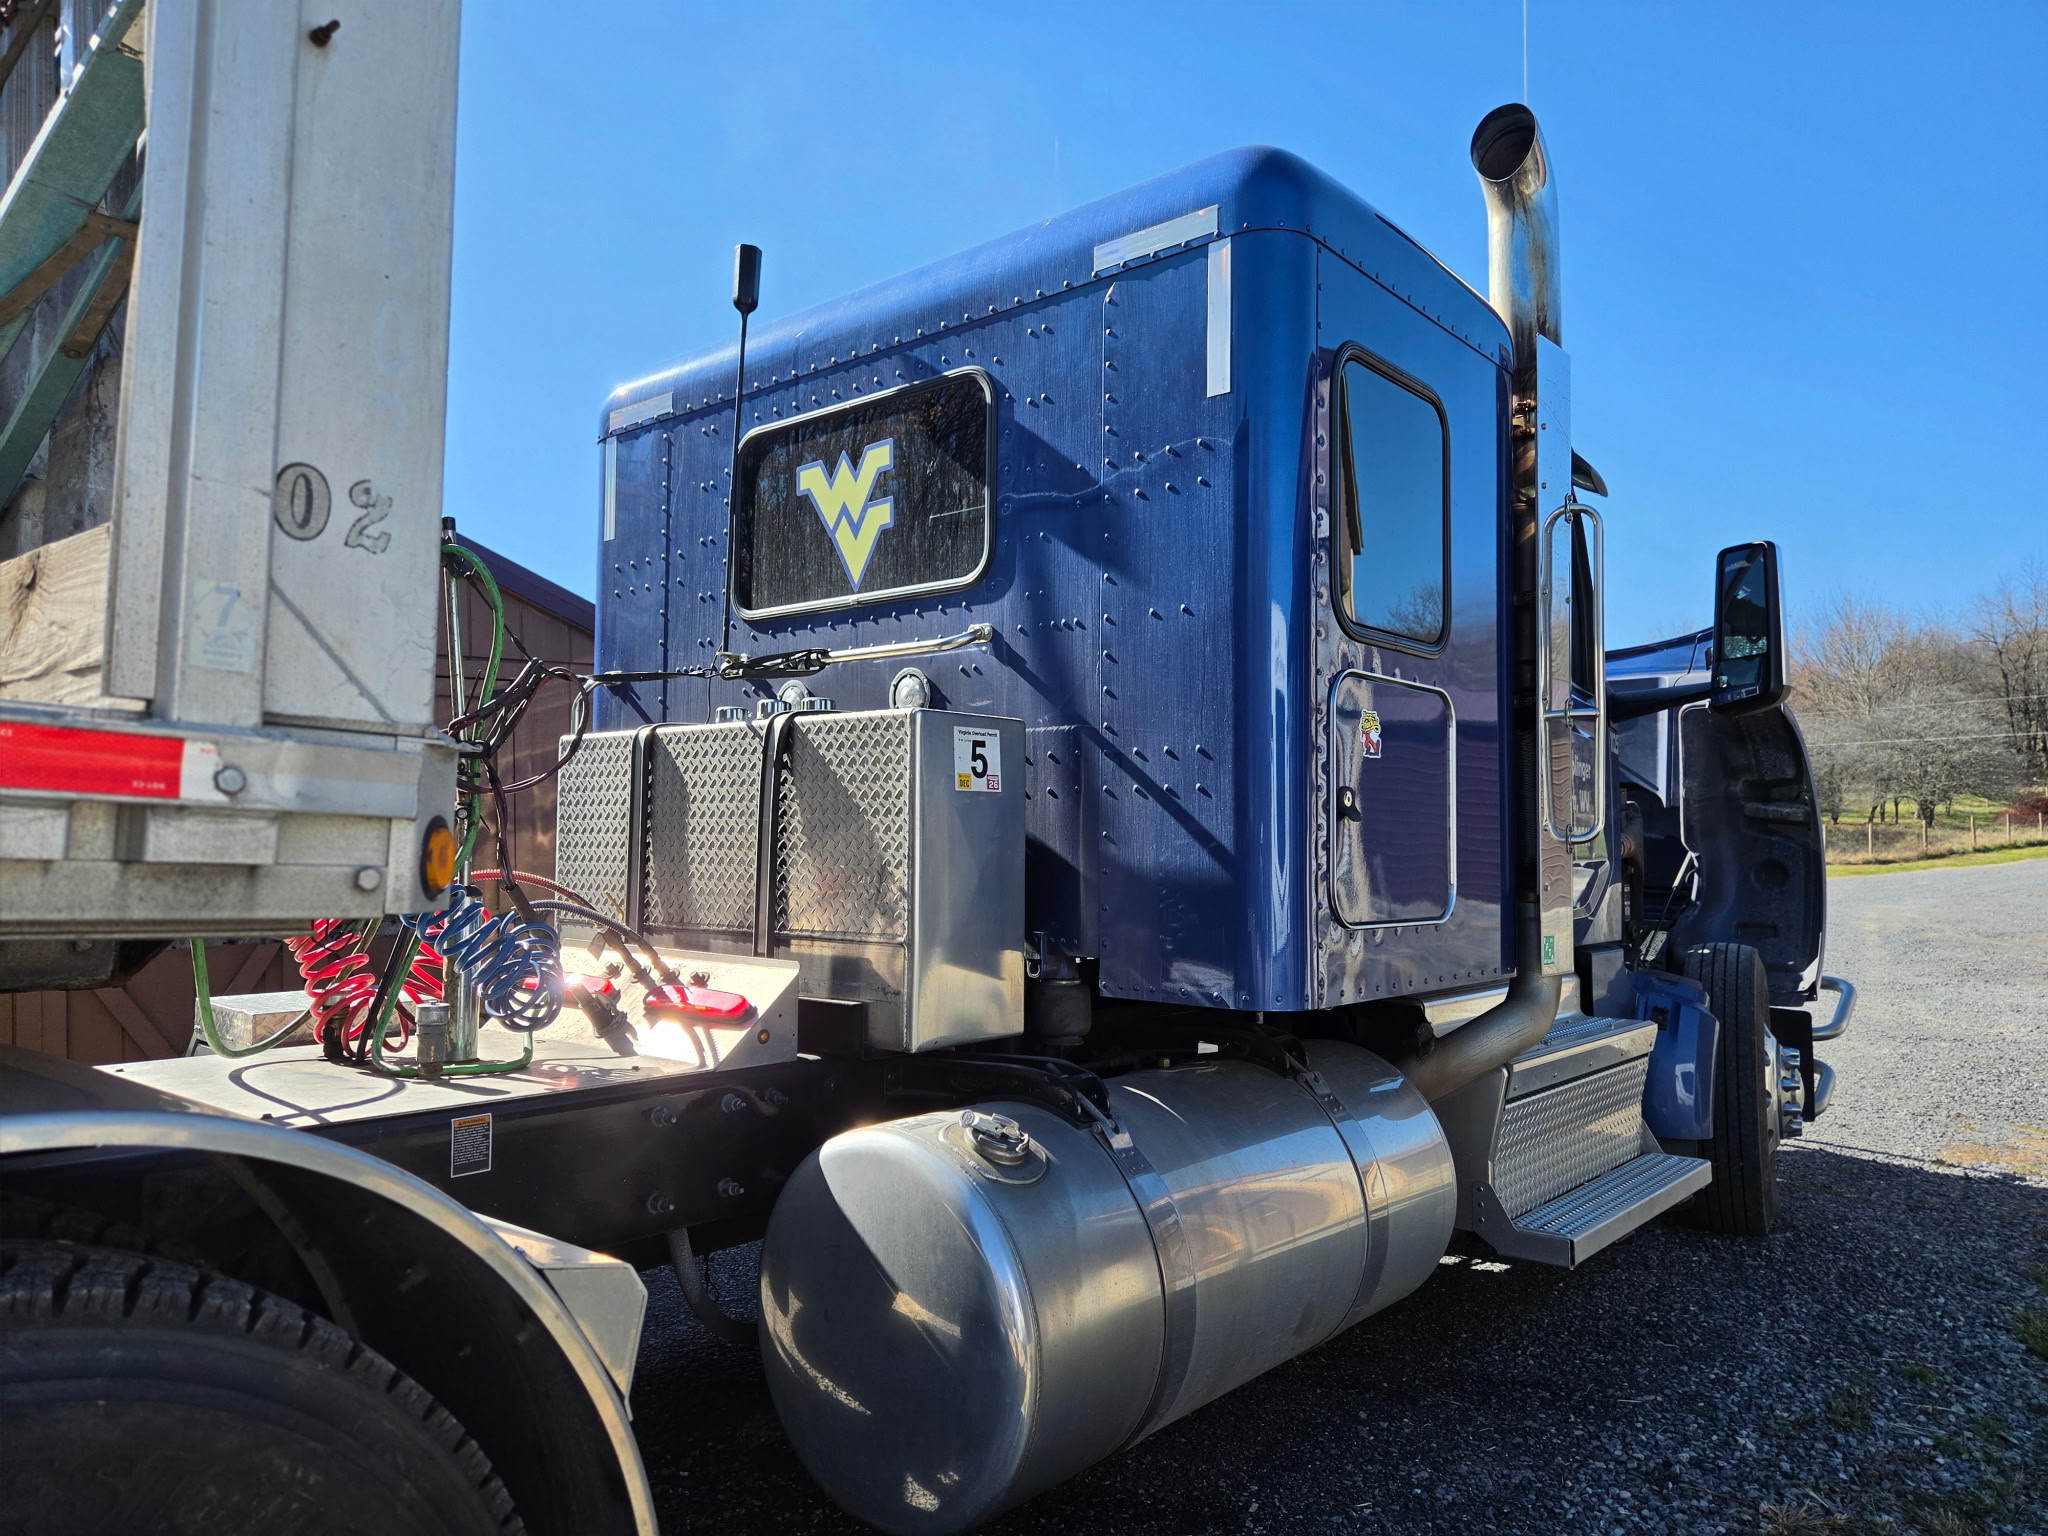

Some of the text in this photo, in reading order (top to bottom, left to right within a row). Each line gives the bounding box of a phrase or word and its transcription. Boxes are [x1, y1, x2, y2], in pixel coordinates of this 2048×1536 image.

[971, 740, 988, 779] 5
[959, 779, 970, 788] DEC
[988, 780, 999, 789] 26
